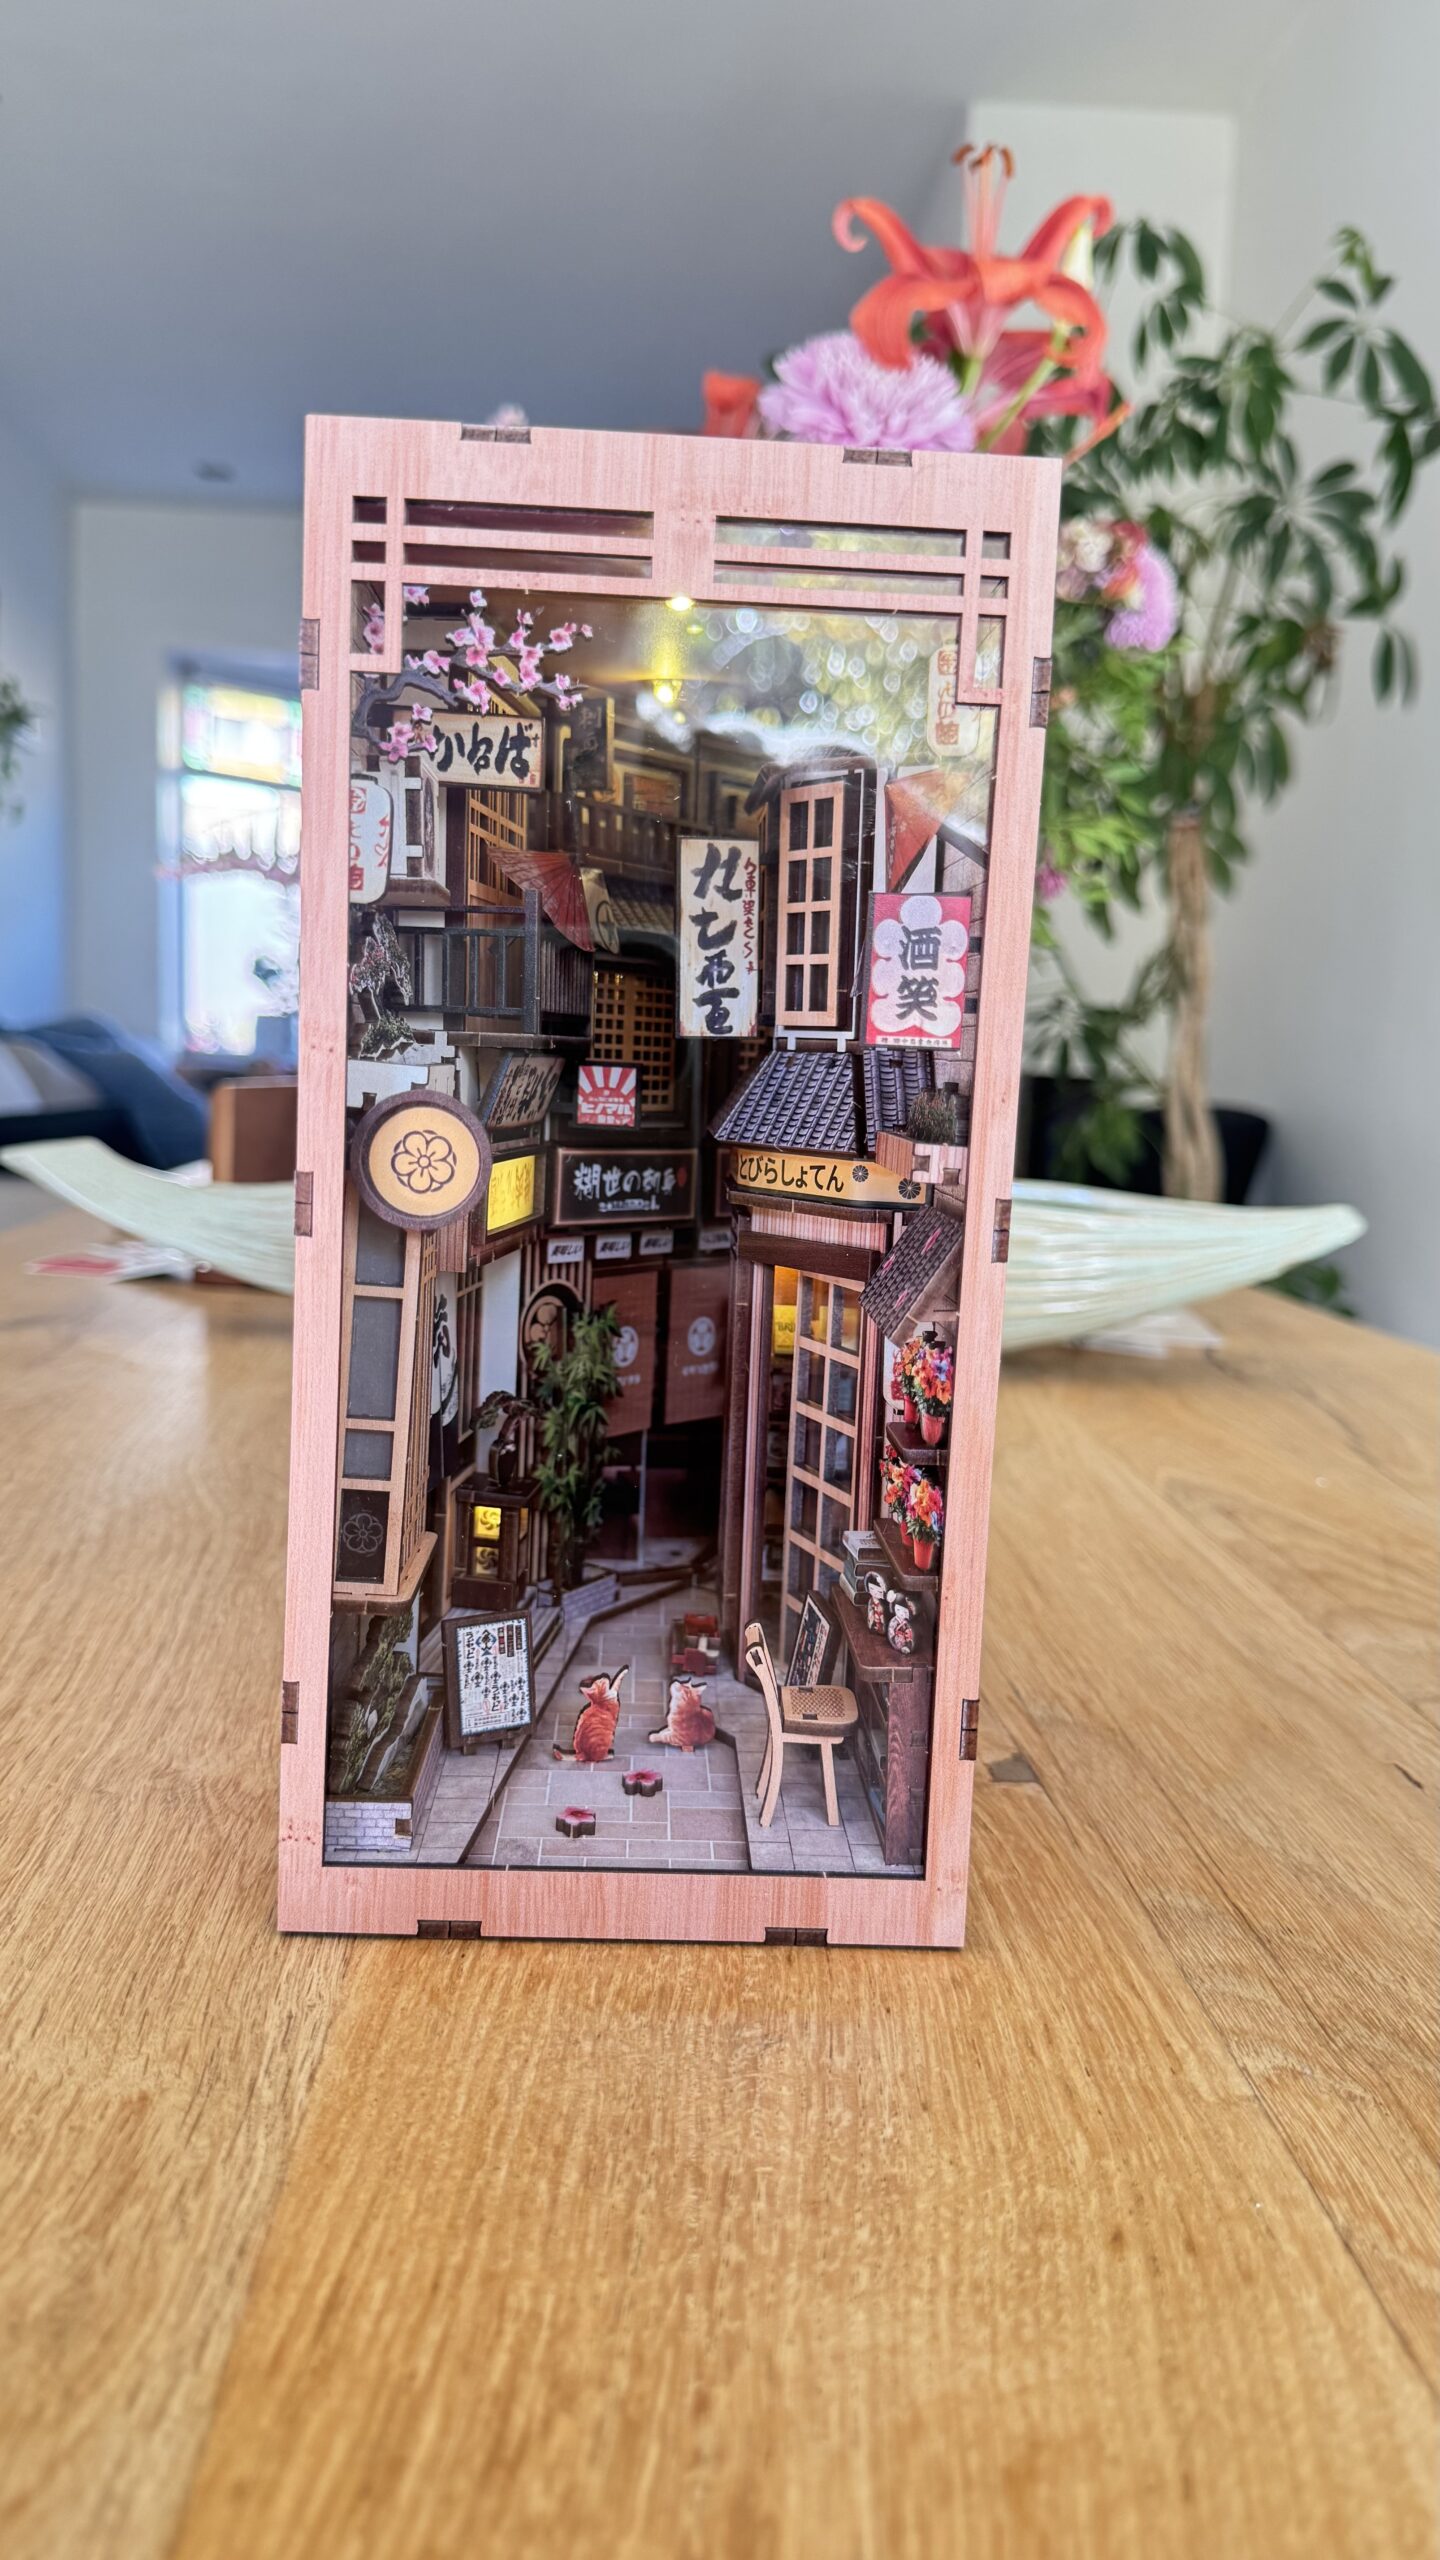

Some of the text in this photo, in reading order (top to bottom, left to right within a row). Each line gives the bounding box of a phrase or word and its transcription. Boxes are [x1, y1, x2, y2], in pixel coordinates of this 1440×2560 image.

[740, 1155, 844, 1193] とびらしょてん
